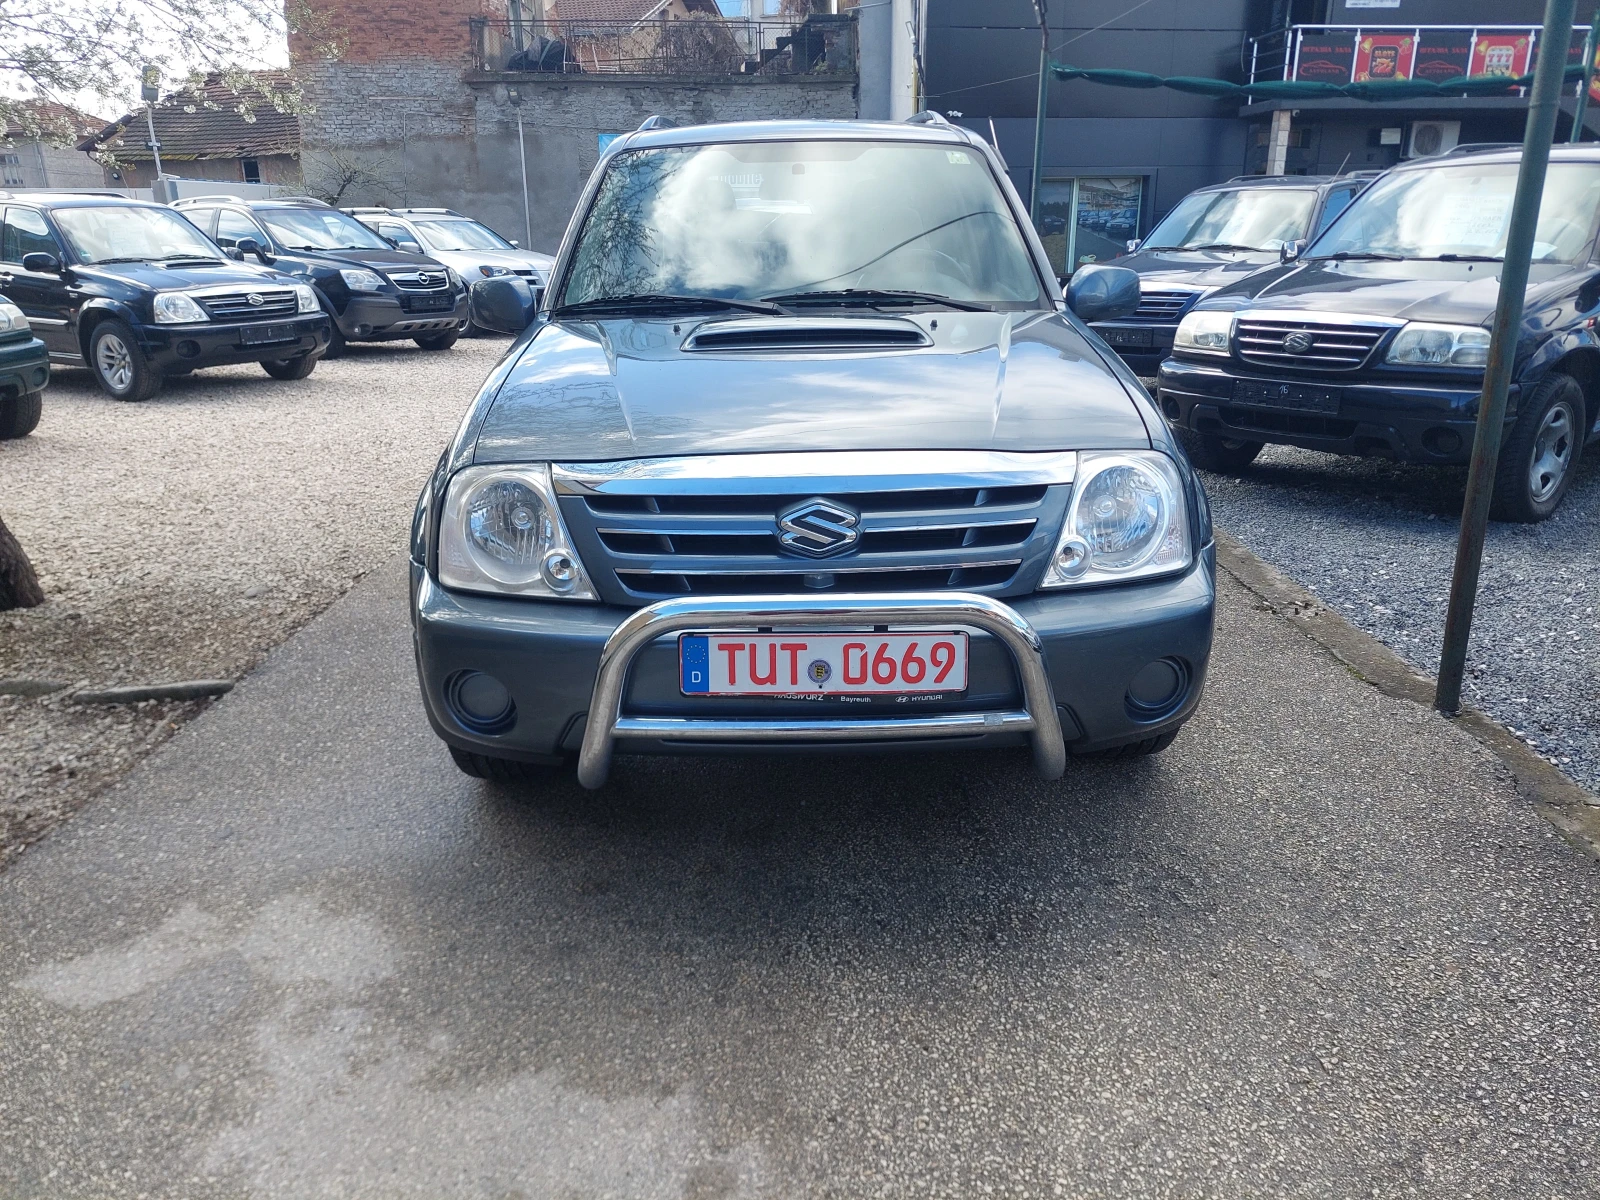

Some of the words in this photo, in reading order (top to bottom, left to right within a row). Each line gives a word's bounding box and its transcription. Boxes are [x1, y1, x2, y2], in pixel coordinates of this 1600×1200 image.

[1488, 54, 1512, 63] 777
[691, 671, 702, 684] D
[717, 643, 808, 686] TUT
[842, 641, 956, 686] 0669
[840, 695, 872, 703] Bayreuth
[911, 694, 943, 702] HYUNDAI
